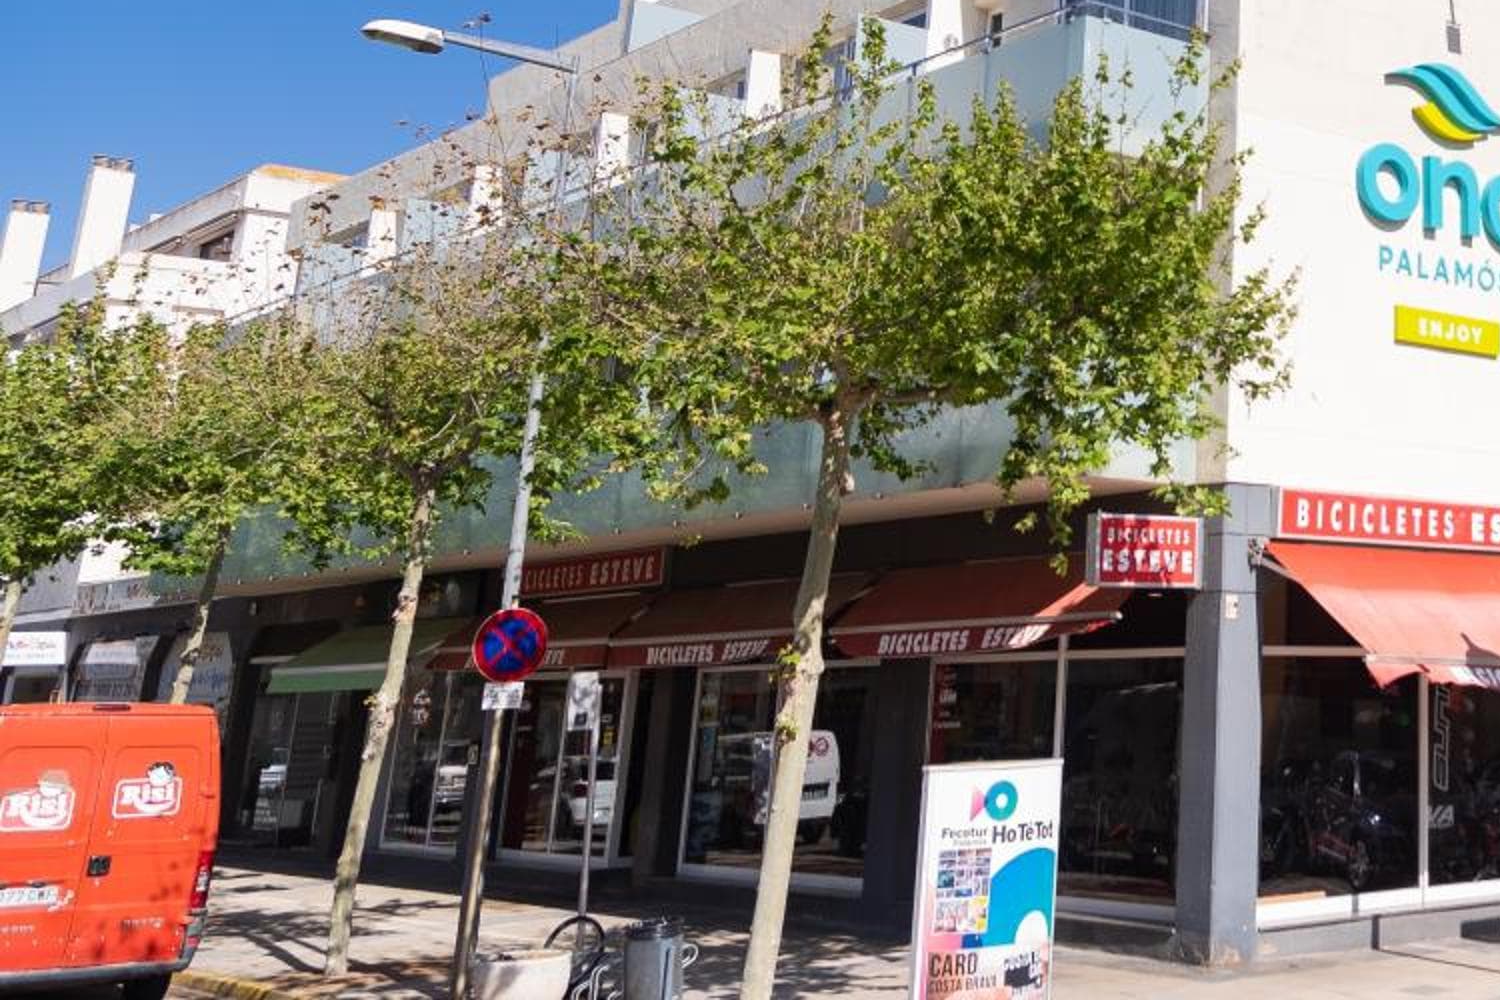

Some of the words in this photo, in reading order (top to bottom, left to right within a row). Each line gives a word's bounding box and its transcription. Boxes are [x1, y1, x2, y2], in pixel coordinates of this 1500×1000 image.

[1418, 318, 1483, 345] ENJOY
[1297, 498, 1456, 539] BICICLETES
[1107, 526, 1191, 545] BICICLETES
[524, 563, 584, 592] CICLETES
[589, 555, 655, 586] ESTEVE
[1103, 548, 1193, 573] ESTEVE
[646, 642, 714, 665] BICICLETES
[878, 629, 971, 655] BICICLETES
[7, 793, 69, 828] Risi
[120, 784, 177, 814] Risi
